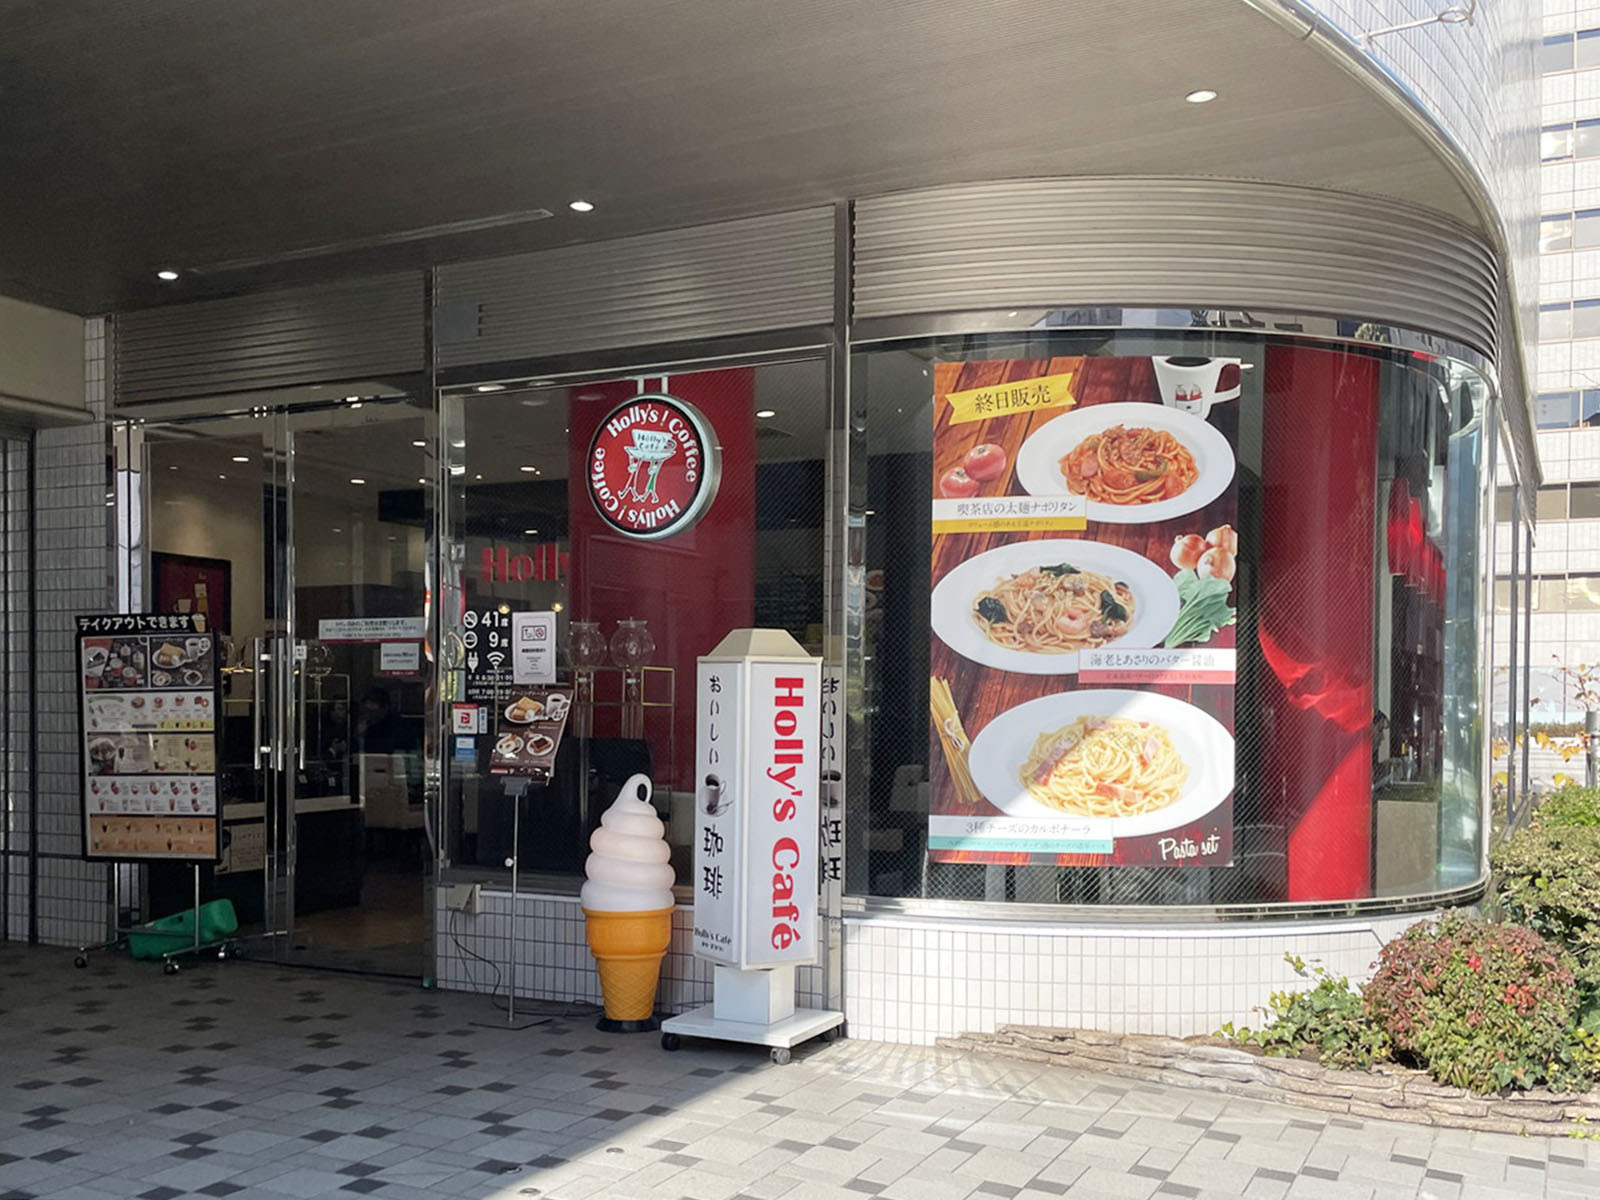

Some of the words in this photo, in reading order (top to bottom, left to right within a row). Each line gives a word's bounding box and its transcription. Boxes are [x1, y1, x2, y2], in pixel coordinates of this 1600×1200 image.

[974, 384, 1052, 414] 終日販売
[606, 403, 660, 438] Holly's
[668, 417, 700, 484] Coffee
[590, 446, 620, 513] Coffee
[626, 498, 682, 529] Holly's
[956, 501, 1078, 517] 喫茶店の太麺ナポリタン
[79, 615, 190, 631] テイクアウトできます
[708, 675, 723, 765] おいしい
[766, 676, 805, 824] Holly's
[964, 820, 1091, 836] 3種チーズのカルボナーラ
[1157, 836, 1199, 861] Pasta
[1200, 833, 1222, 857] set
[702, 824, 725, 900] 珈琲
[770, 836, 802, 950] Café
